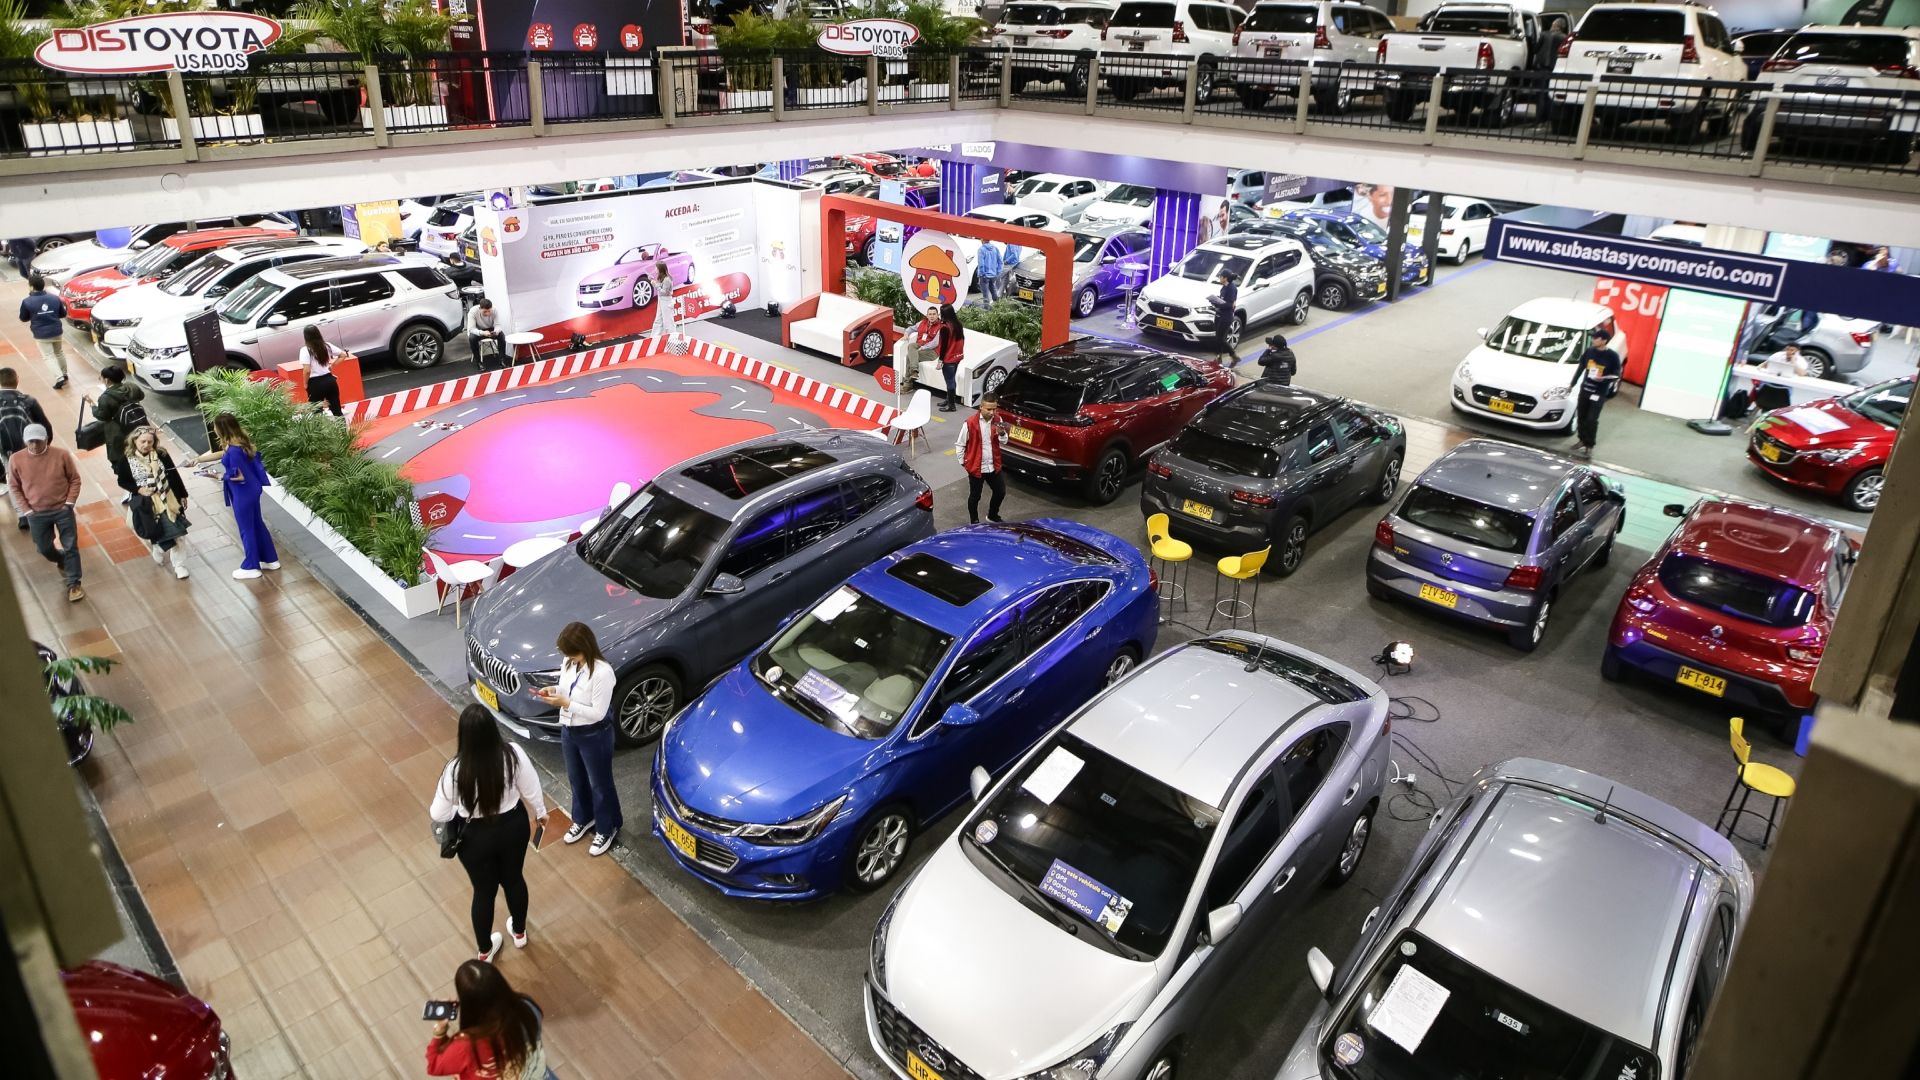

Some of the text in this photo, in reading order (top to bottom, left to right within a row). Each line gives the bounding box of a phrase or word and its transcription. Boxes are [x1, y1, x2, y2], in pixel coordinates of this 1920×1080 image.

[53, 27, 264, 52] DISTOYOTA
[826, 25, 911, 46] DISTOYOTA
[872, 45, 903, 57] USADOS
[174, 53, 246, 70] USADOS
[664, 203, 700, 219] ACCEDA A:
[1509, 234, 1775, 288] www.subastasycomercio.com
[1421, 584, 1457, 604] EIV 502
[666, 822, 679, 840] JCT
[1055, 872, 1068, 884] GPS
[1047, 885, 1093, 915] Precio especial
[1502, 1015, 1519, 1029] 535
